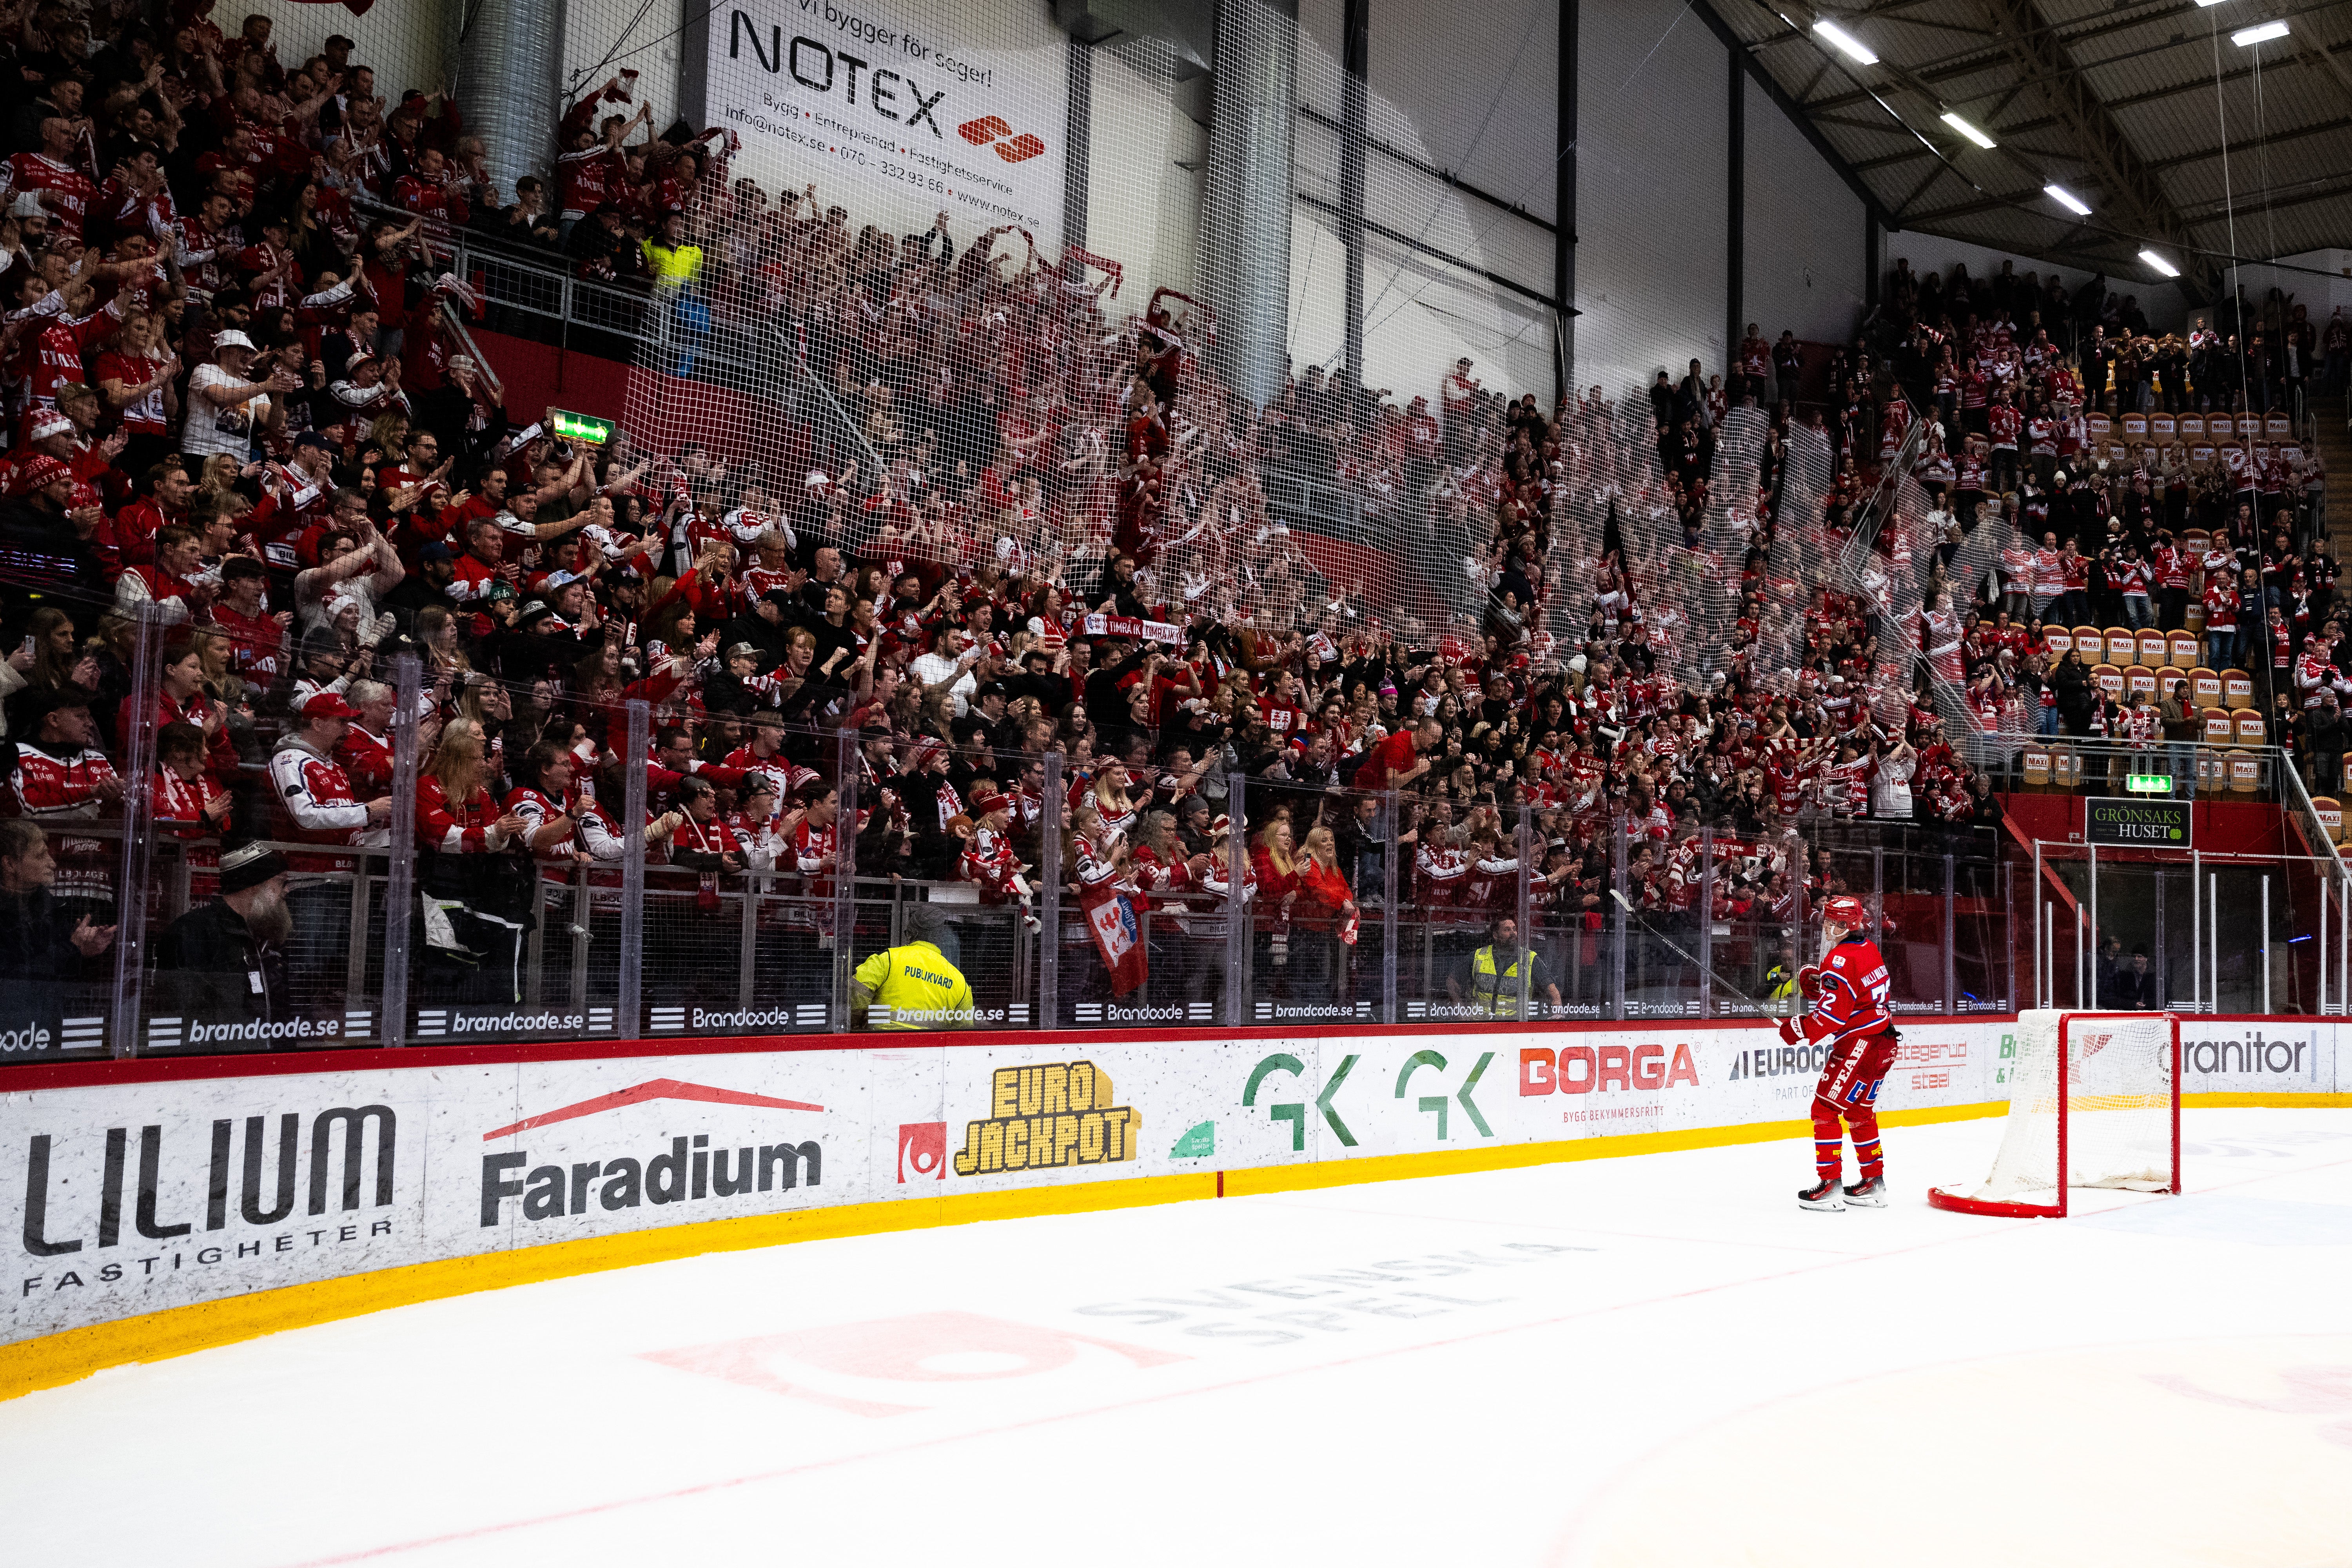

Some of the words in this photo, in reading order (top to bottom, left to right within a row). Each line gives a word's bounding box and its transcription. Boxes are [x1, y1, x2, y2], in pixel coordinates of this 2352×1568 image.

[825, 5, 897, 46] bygger
[902, 34, 929, 60] för
[936, 53, 992, 87] seger!
[730, 9, 945, 139] NOTEX
[764, 93, 799, 119] Bygg
[815, 113, 895, 153] Entreprenad
[911, 148, 1013, 196] Fastighetsservice
[726, 104, 825, 151] info@notex.se
[841, 146, 865, 165] 070
[881, 161, 904, 180] 332
[909, 171, 924, 187] 93
[958, 191, 1040, 228] www.notex.se
[1109, 620, 1132, 634] TIMRÅ
[1133, 624, 1141, 635] IK
[2095, 806, 2181, 824] GRÖNSAKS
[2118, 824, 2170, 838] HUSET
[904, 965, 953, 989] PUBLIKVÄRD
[897, 1006, 1004, 1022] brandcode.se
[1108, 1004, 1183, 1020] Brandcode
[1276, 1004, 1353, 1018] brandcode.se
[1430, 1002, 1484, 1017] Brandcode
[1642, 1002, 1683, 1014] Brandcode
[1898, 1002, 1933, 1010] brandcode.se
[1969, 1001, 1996, 1010] Brandcode
[453, 1011, 583, 1032] brandcode.se
[693, 1006, 788, 1027] Brandcode
[189, 1017, 338, 1043] brandcode.se
[1896, 1041, 1966, 1062] stegerud
[1520, 1044, 1699, 1096] BORGA
[1831, 1046, 1864, 1094] PEAB
[1912, 1069, 1949, 1089] steel
[995, 1062, 1094, 1118] EURO
[1395, 1050, 1495, 1140] GK
[1776, 1087, 1798, 1101] PART
[1803, 1085, 1813, 1097] OF
[1243, 1053, 1361, 1151] GK
[1564, 1110, 1586, 1123] BYGG
[1589, 1105, 1664, 1121] BEKYMMERSFRITT
[955, 1106, 1131, 1176] JACKPOT
[23, 1105, 396, 1256] LILIUM
[481, 1134, 821, 1227] Faradium
[23, 1220, 391, 1297] FASTIGHETER
